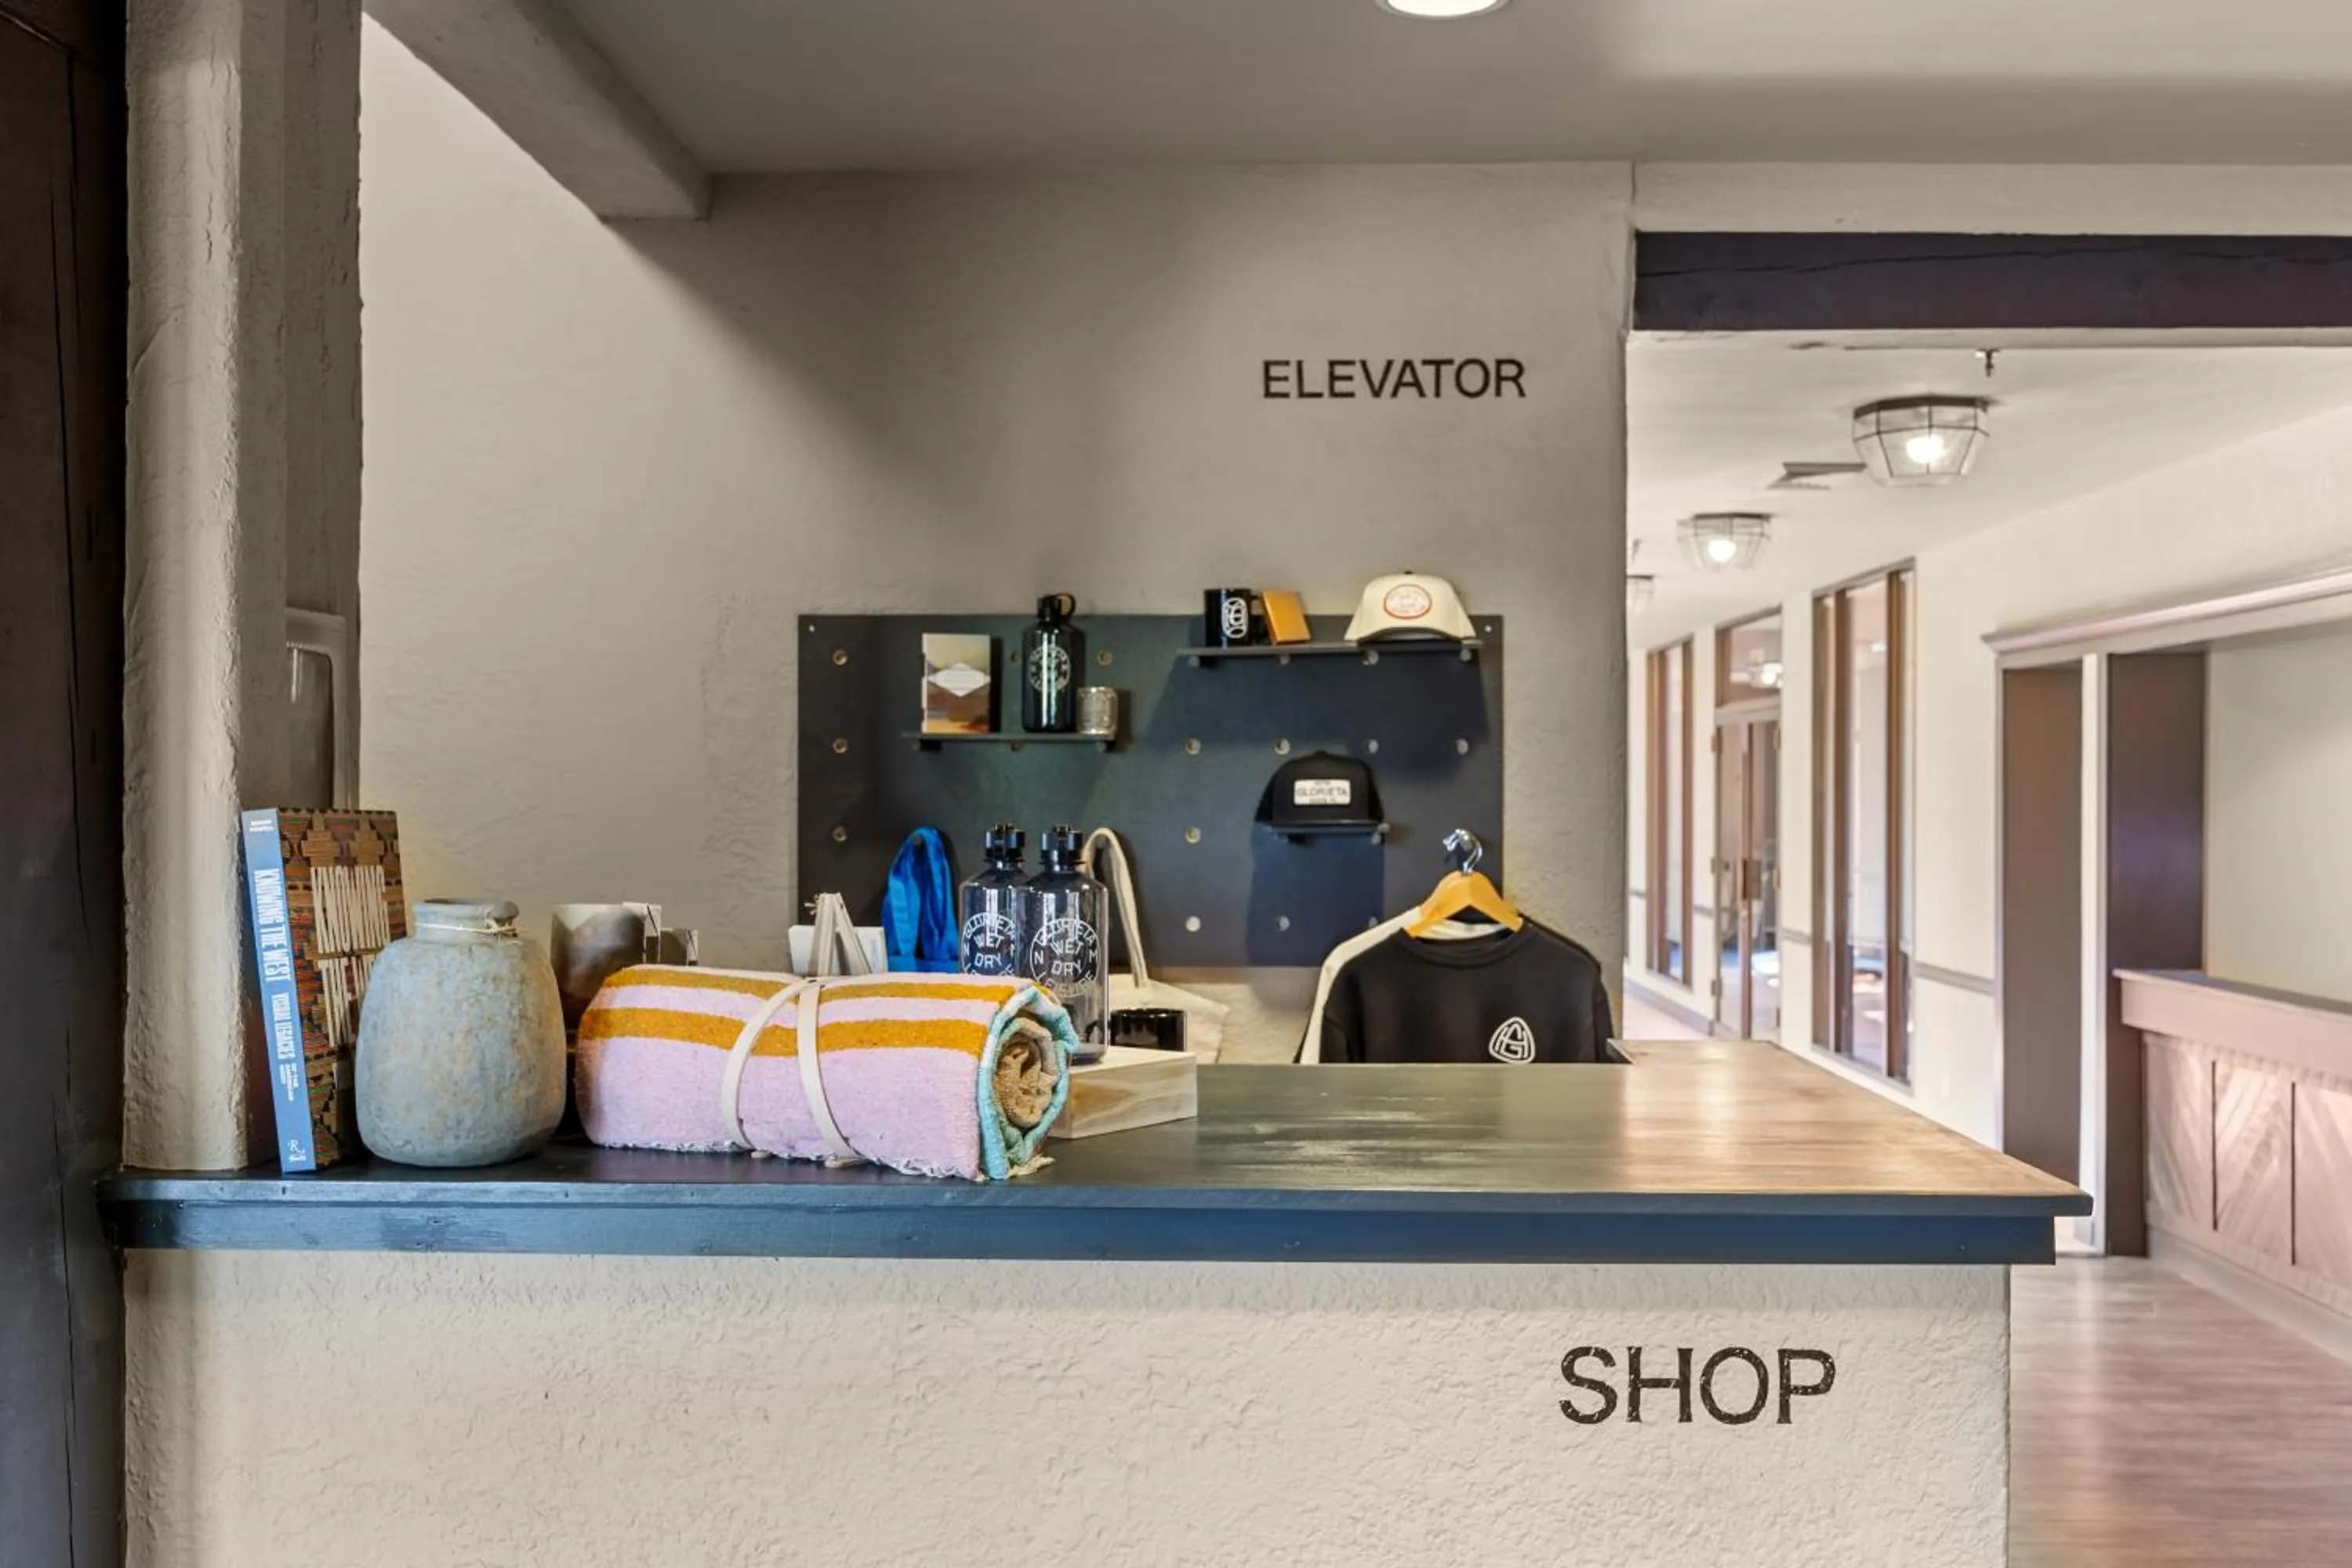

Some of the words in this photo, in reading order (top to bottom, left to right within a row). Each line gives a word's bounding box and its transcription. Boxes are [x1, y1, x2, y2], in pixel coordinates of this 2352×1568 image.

[1262, 358, 1527, 399] ELEVATOR
[254, 869, 285, 925] KNOWING
[310, 865, 390, 954] KNOWING
[260, 924, 287, 950] THE
[973, 933, 1005, 949] WET
[1050, 938, 1084, 956] WET
[263, 949, 291, 982] WEST
[975, 953, 1002, 968] DRY
[1051, 960, 1082, 975] DRY
[1559, 1345, 1836, 1425] SHOP
